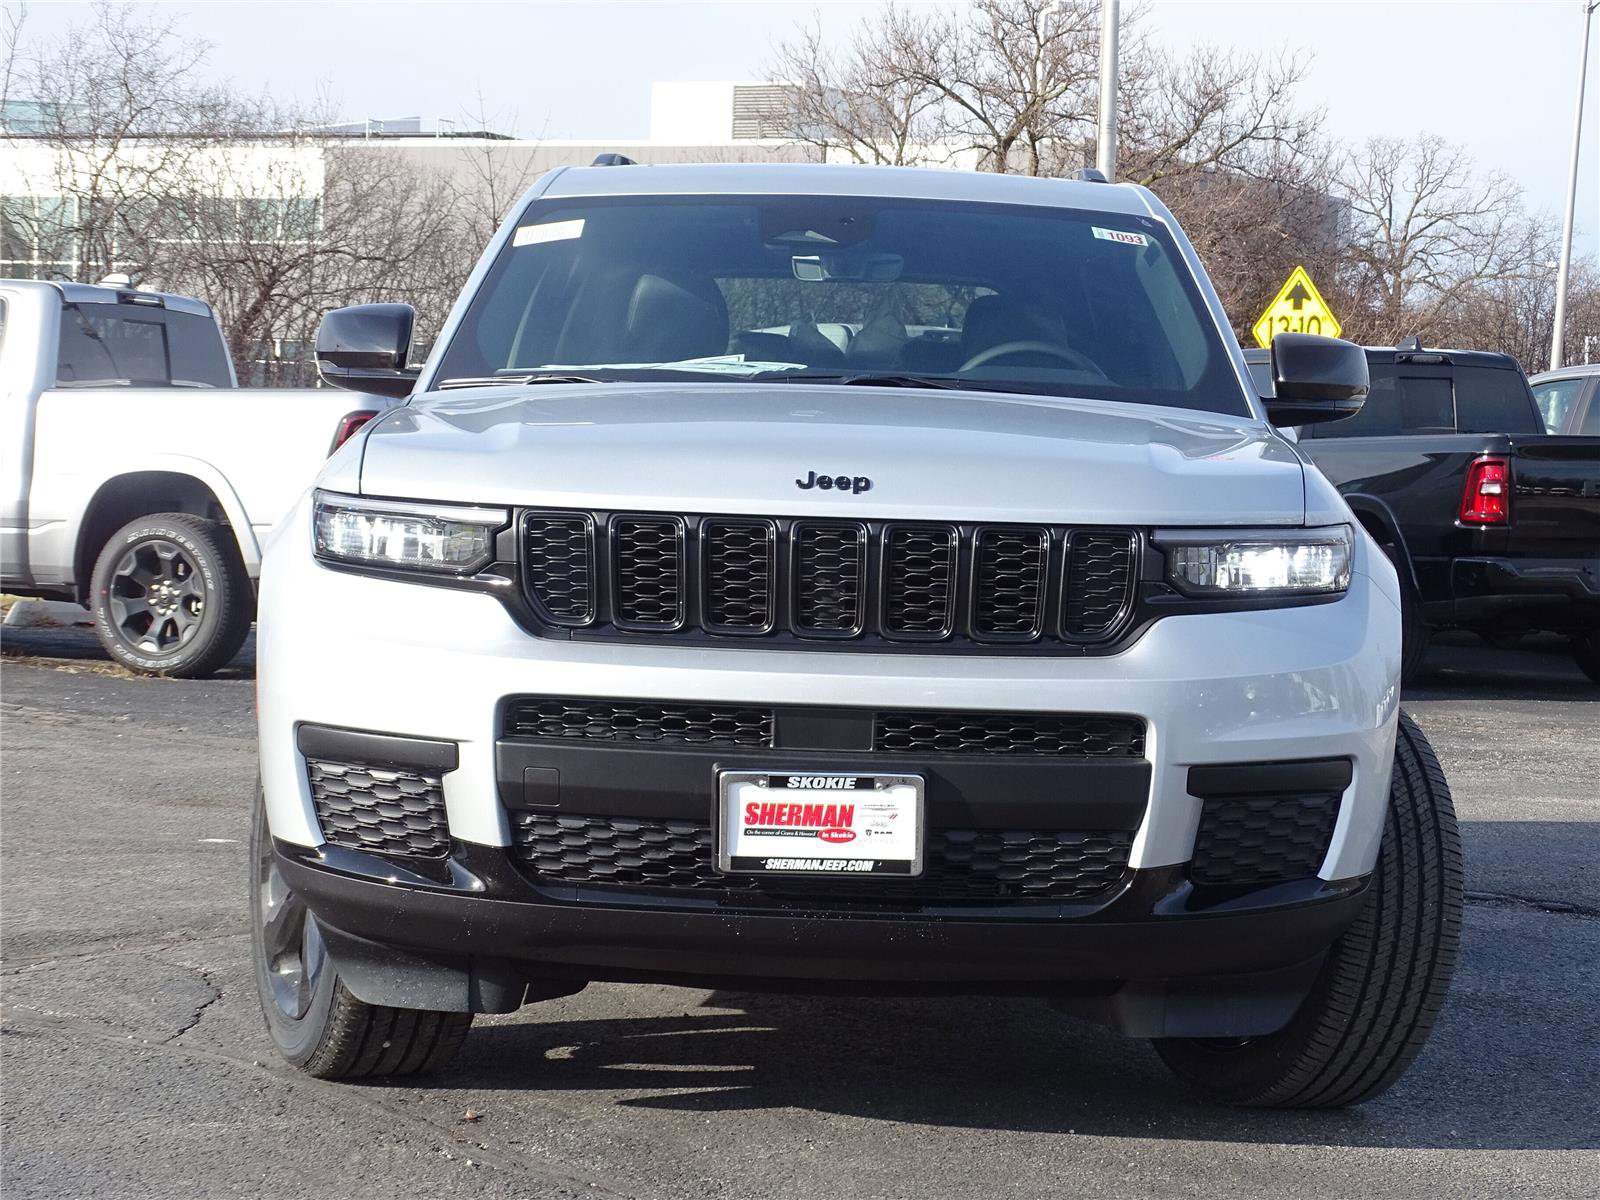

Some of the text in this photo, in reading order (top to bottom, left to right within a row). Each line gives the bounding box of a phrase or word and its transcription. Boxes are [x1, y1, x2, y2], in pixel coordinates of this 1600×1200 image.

[1107, 232, 1143, 245] 1093
[796, 471, 872, 494] Jeep
[787, 776, 856, 789] SKOKIE
[744, 802, 855, 827] SHERMAN
[765, 859, 874, 872] SHERMANJEEP.COM
